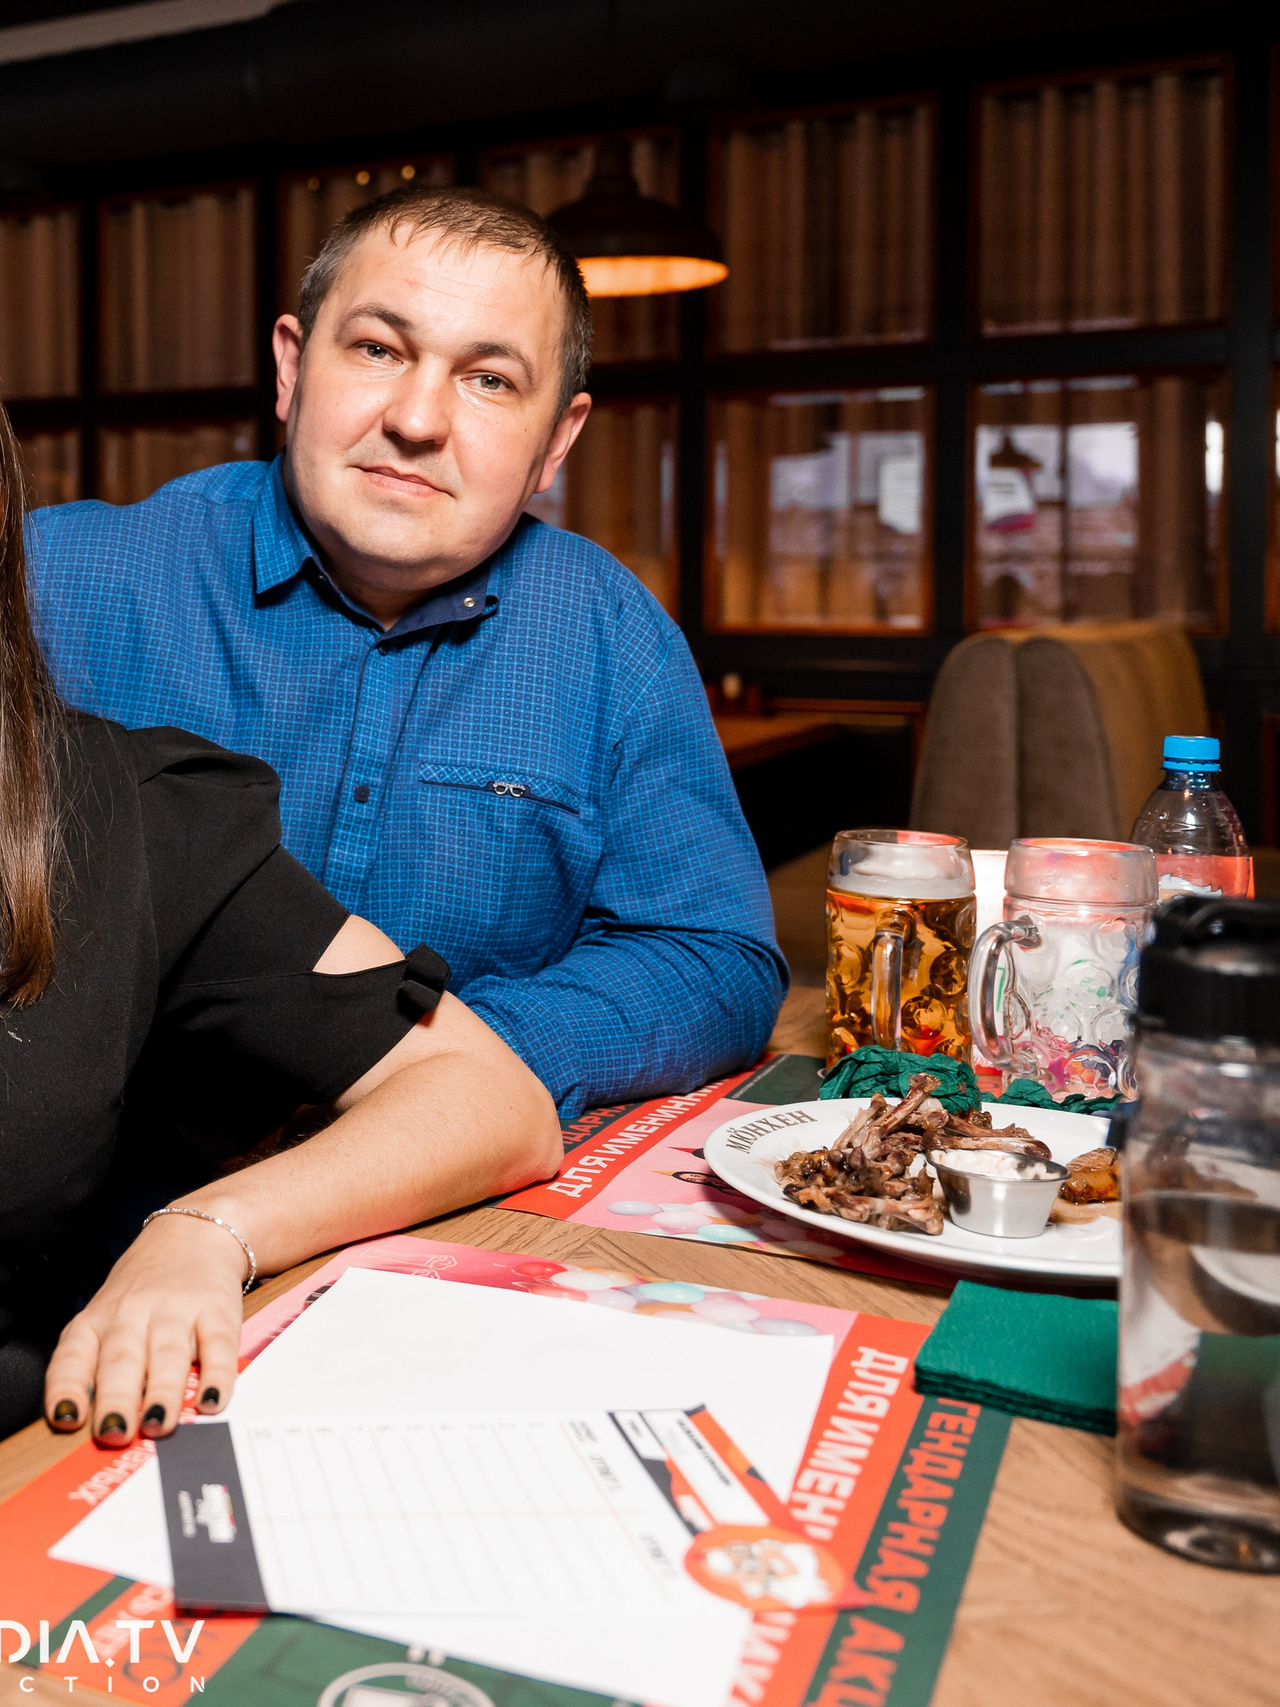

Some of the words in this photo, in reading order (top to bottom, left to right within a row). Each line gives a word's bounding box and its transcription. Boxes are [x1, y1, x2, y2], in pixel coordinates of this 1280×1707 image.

[546, 1153, 616, 1198] ДЛЯ
[593, 1079, 729, 1155] ИМЕНИНН
[837, 1346, 909, 1418] ДЛЯ
[866, 1397, 983, 1614] ГЕНДАРНАЯ
